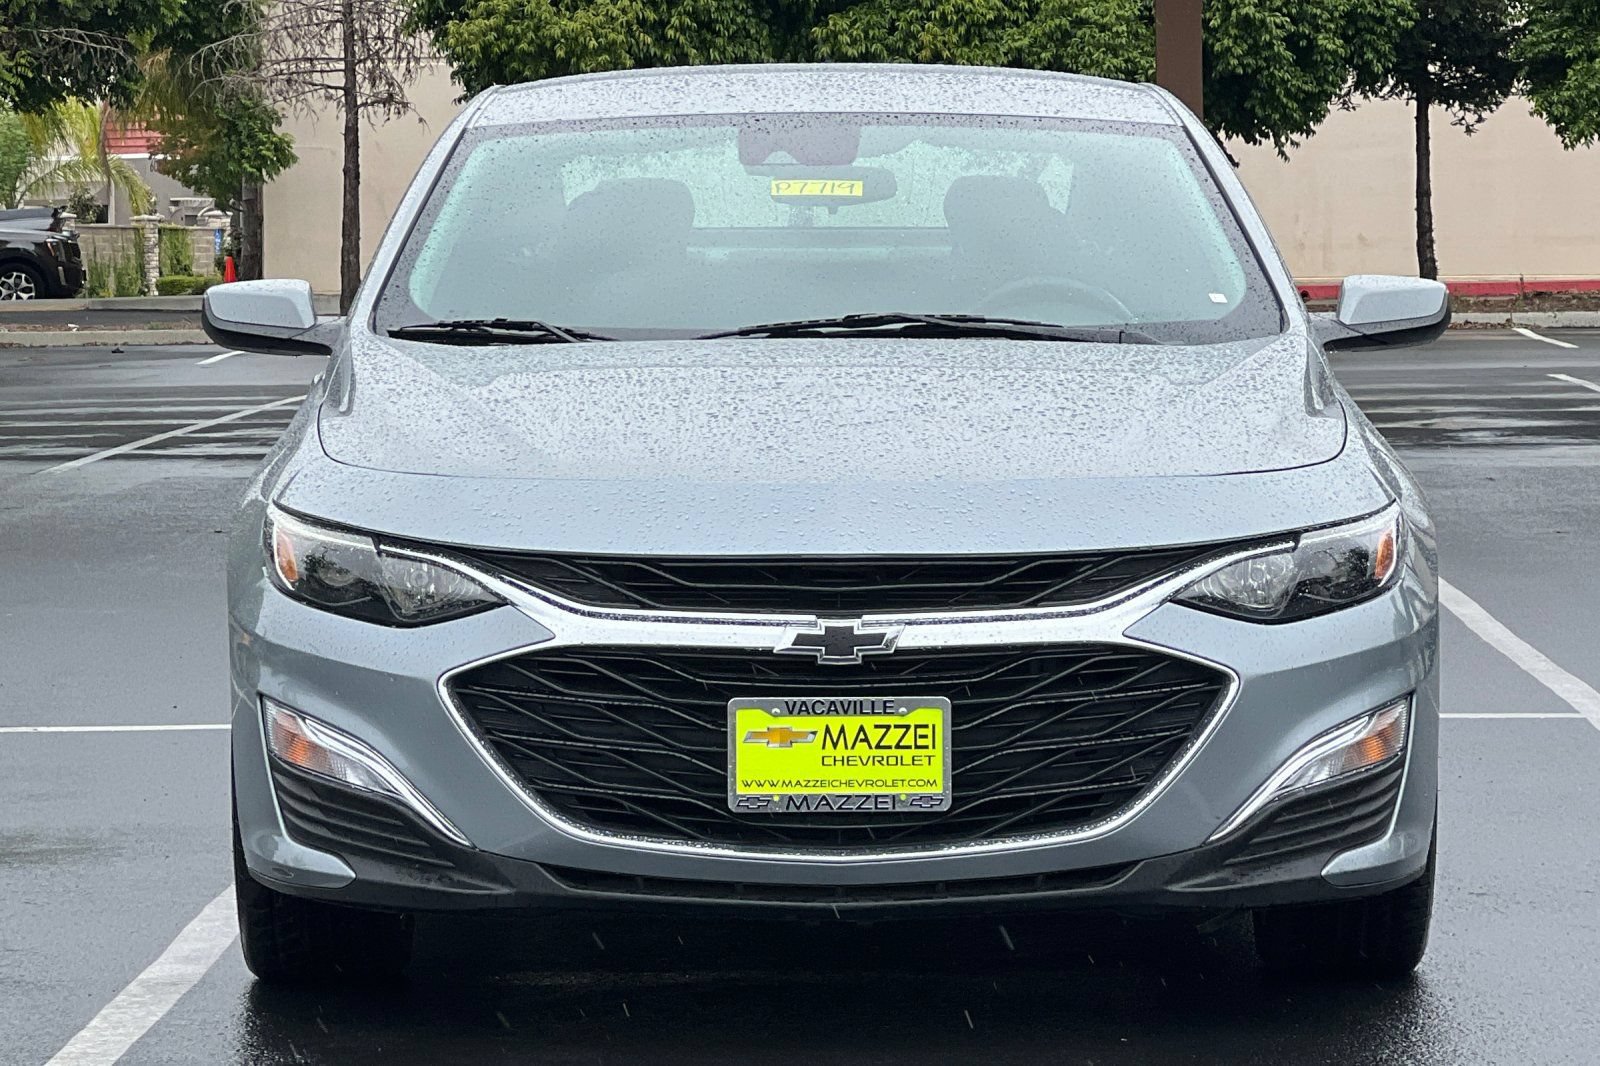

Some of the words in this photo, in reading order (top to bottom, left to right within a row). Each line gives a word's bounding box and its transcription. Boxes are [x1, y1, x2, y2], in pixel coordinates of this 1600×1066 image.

[785, 700, 895, 715] VACAVILLE
[821, 724, 936, 750] MAZZEI
[821, 755, 936, 766] CHEVROLET
[741, 779, 938, 788] WWW.MAZZEICHEVROLET.COM
[786, 795, 896, 810] MAZZEI
